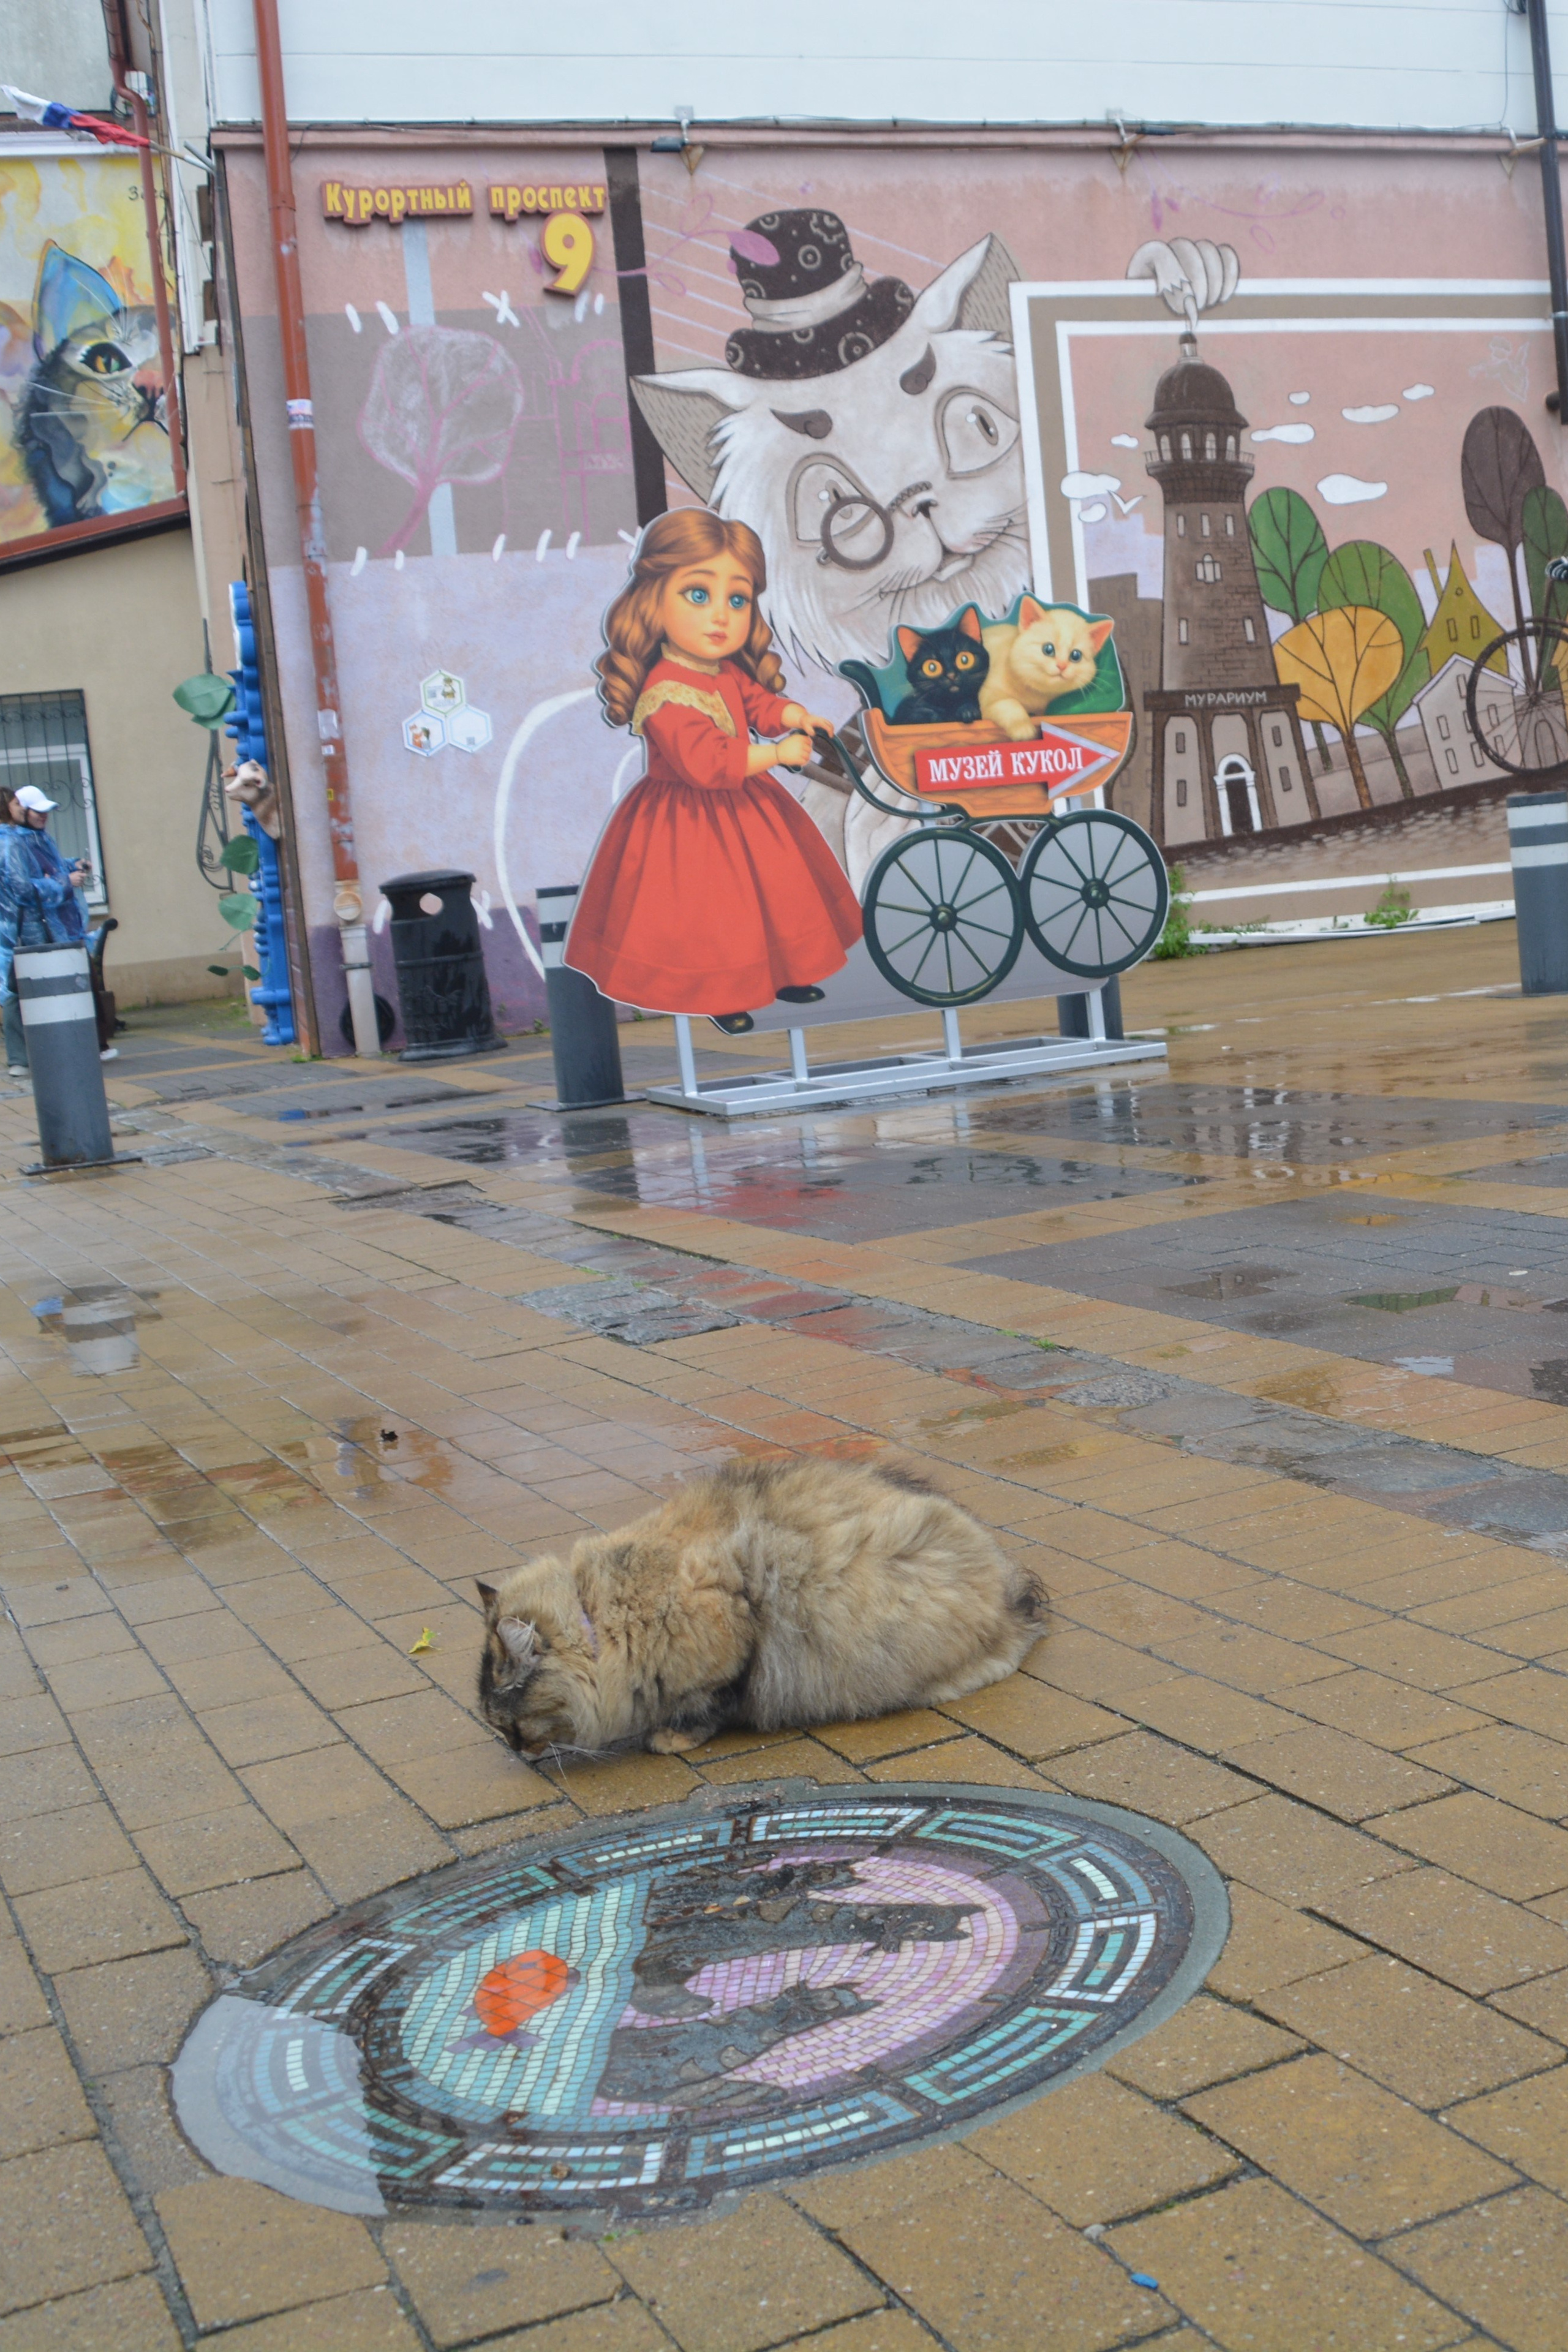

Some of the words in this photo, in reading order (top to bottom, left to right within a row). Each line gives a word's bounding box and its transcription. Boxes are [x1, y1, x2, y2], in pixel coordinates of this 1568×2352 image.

[325, 181, 471, 219] Курортный
[491, 186, 606, 216] проспект
[544, 213, 593, 291] 9
[1185, 691, 1267, 707] МУРАРИУМ
[929, 750, 1004, 783] МУЗЕЙ
[1011, 747, 1084, 775] КУКОЛ
